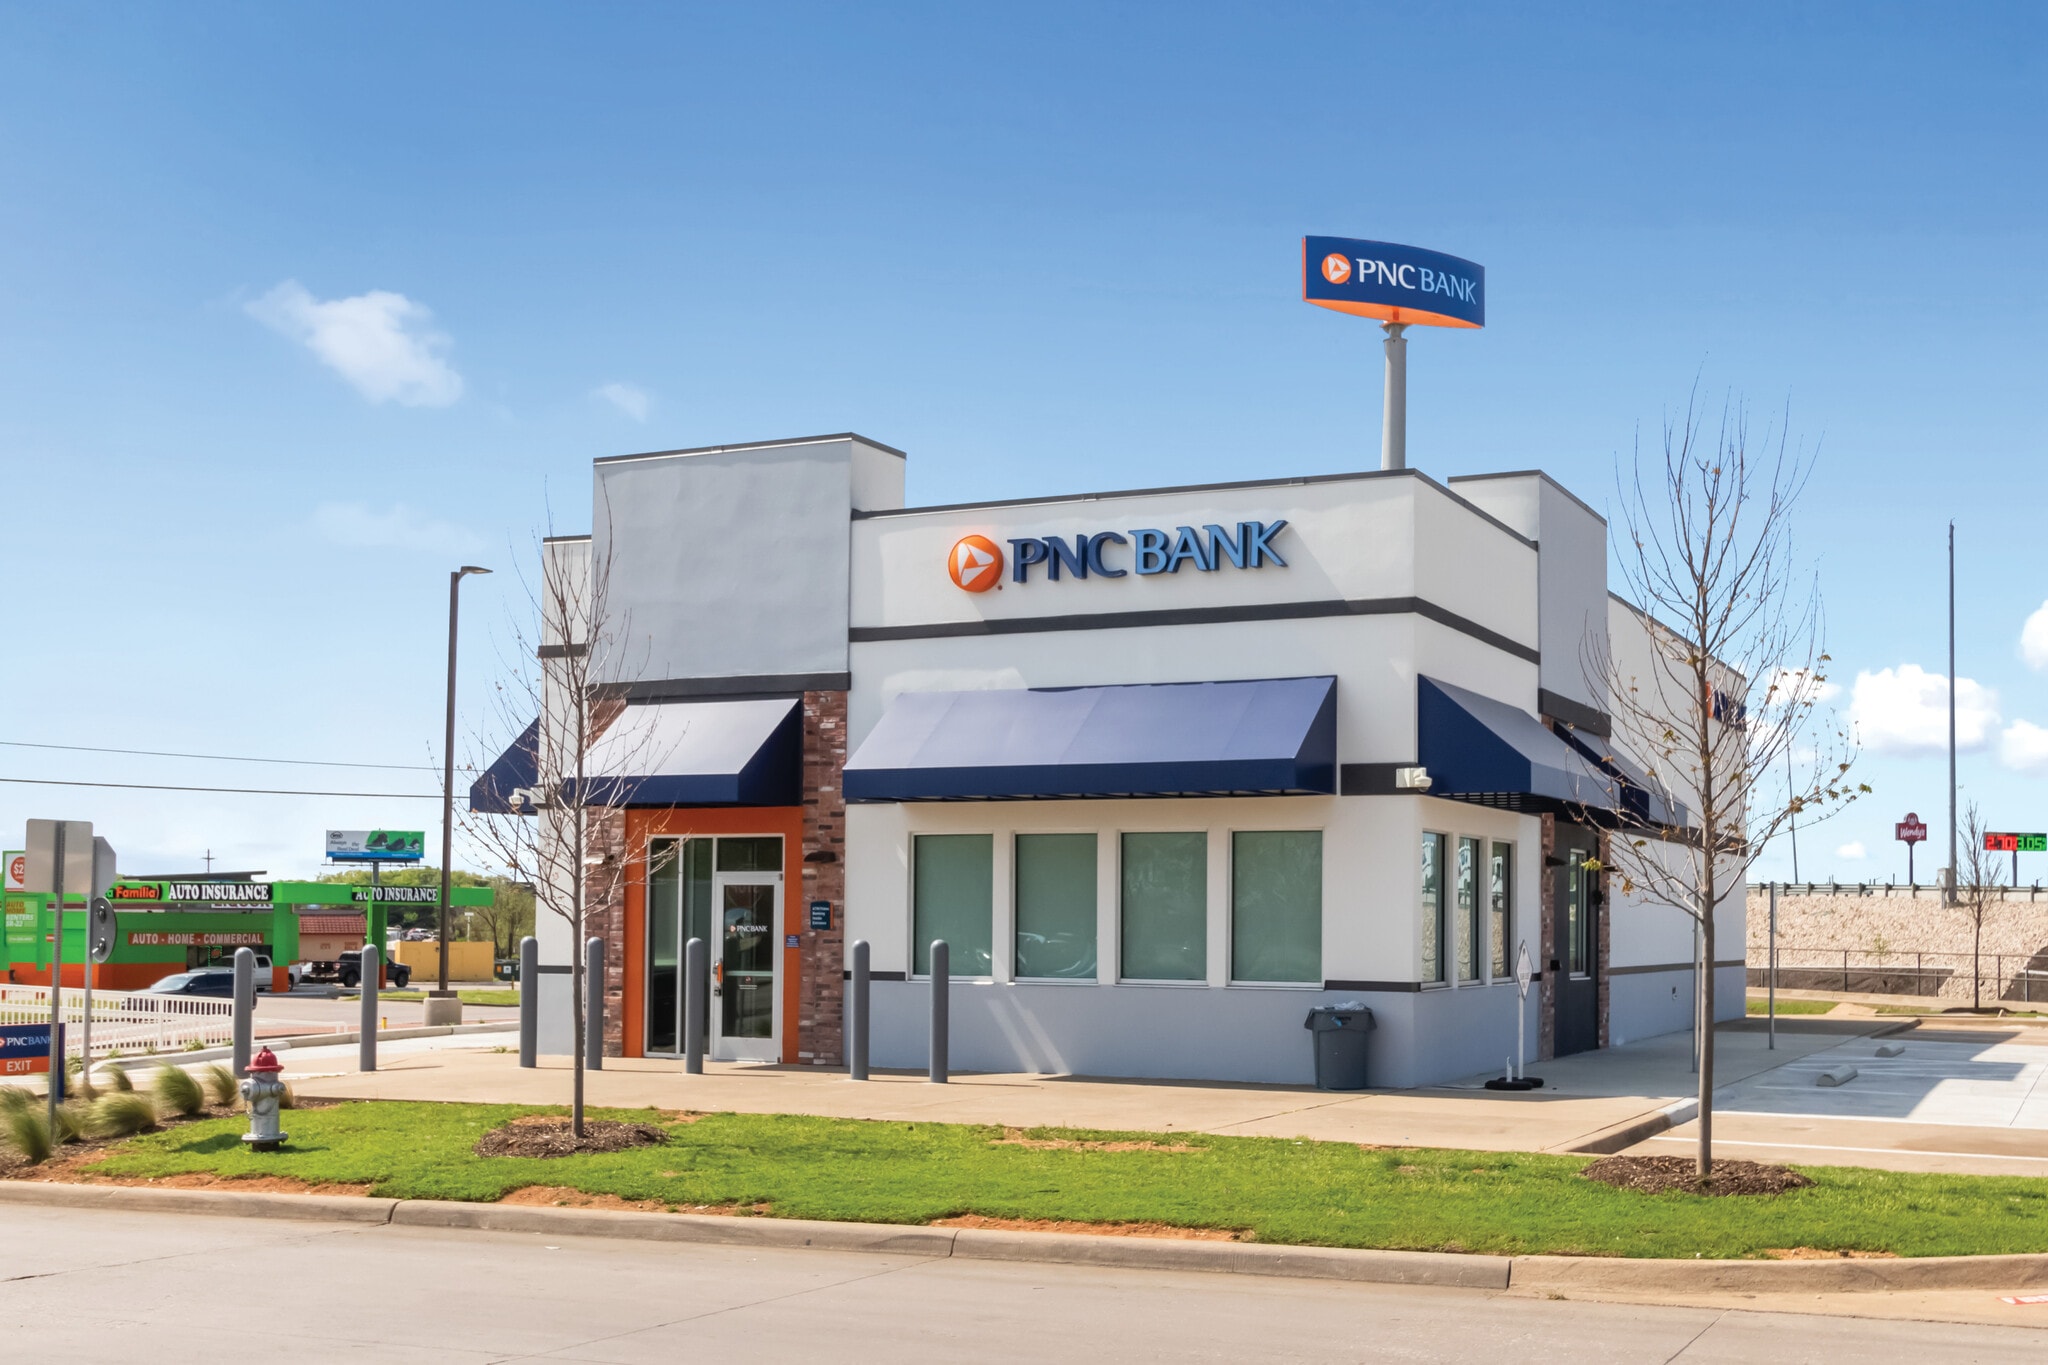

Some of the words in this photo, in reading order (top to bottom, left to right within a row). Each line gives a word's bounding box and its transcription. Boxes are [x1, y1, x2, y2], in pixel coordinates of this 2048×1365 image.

[168, 884, 200, 901] AUTO
[201, 884, 269, 901] INSURANCE
[384, 887, 438, 902] INSURANCE
[132, 933, 158, 944] AUTO
[167, 933, 195, 945] HOME
[203, 933, 262, 945] COMMERCIAL
[6, 1060, 32, 1072] EXIT
